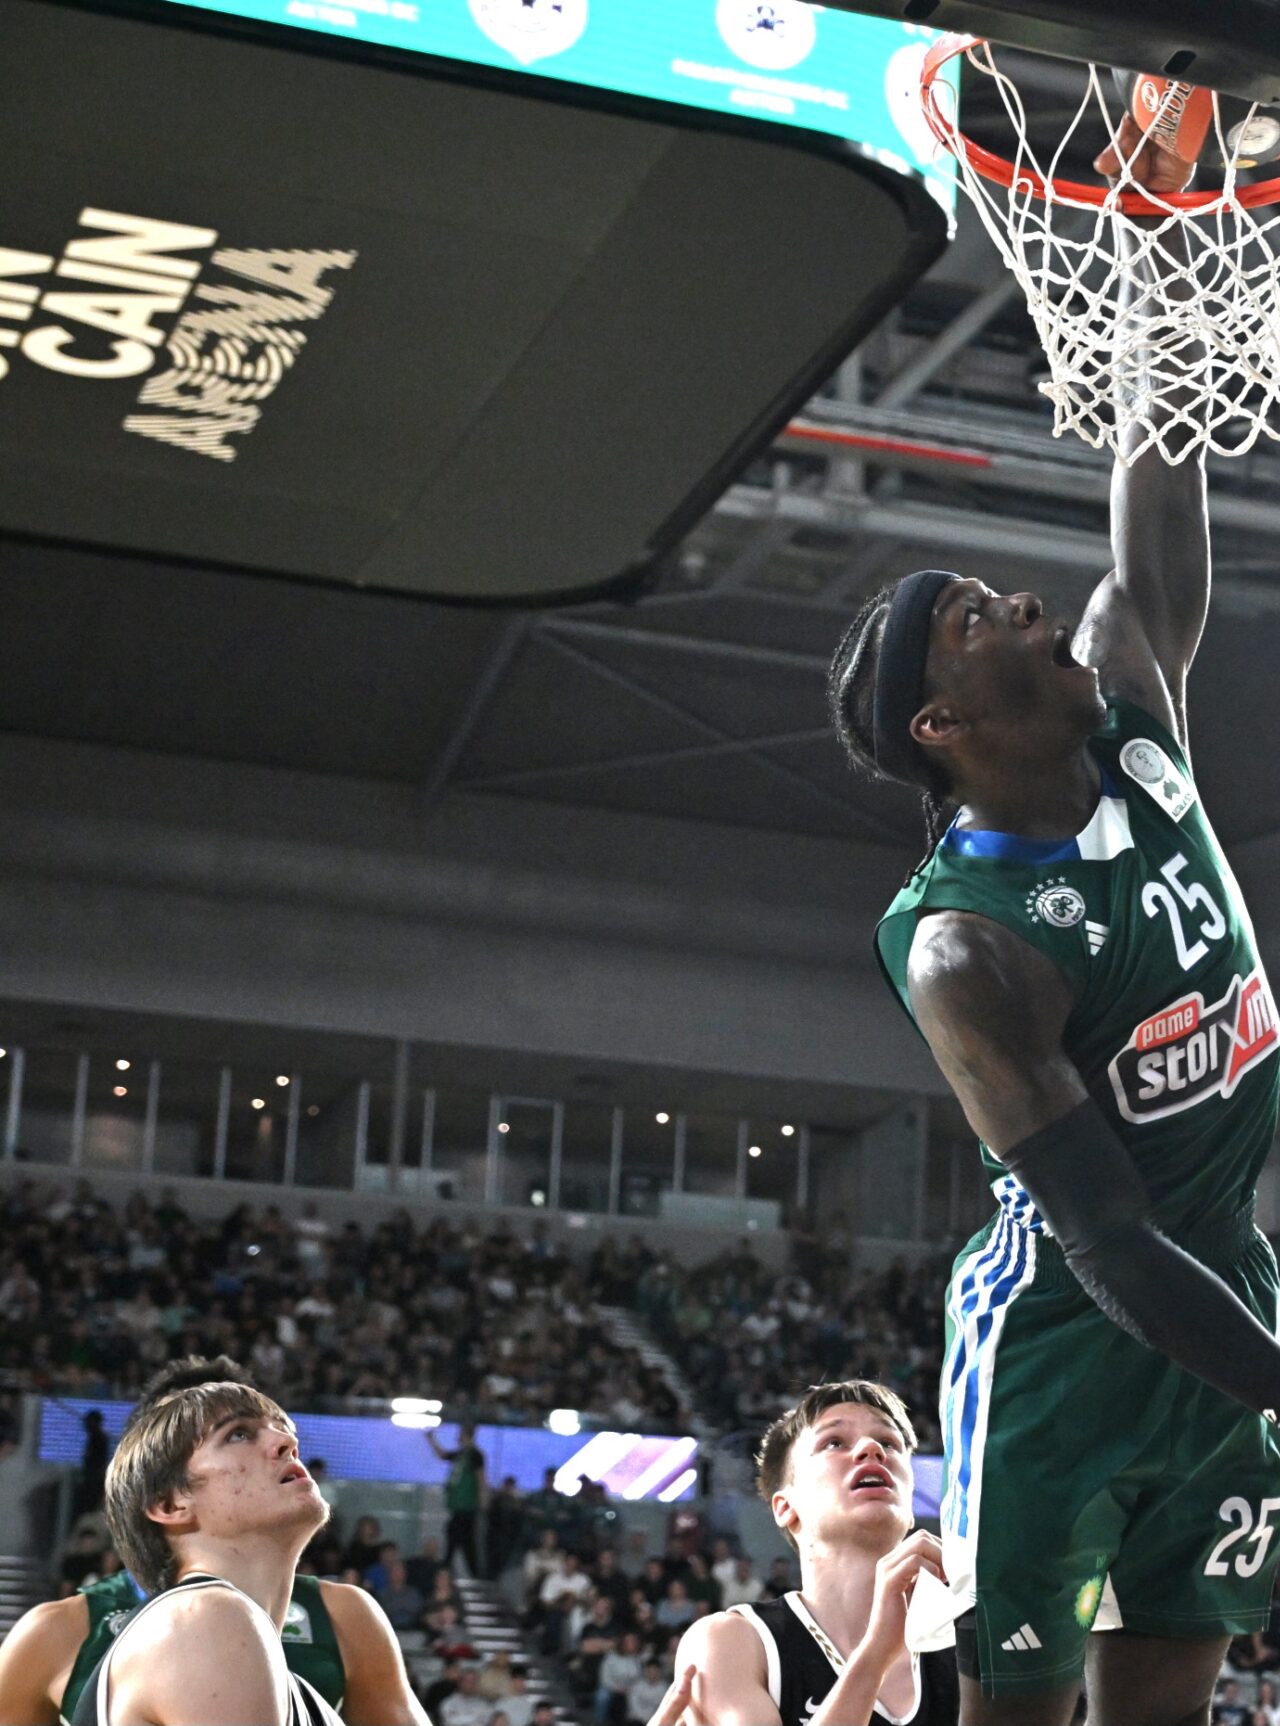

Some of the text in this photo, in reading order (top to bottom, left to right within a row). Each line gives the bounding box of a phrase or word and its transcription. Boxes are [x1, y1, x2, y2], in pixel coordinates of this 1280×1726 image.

[22, 207, 219, 379] CAIN
[122, 249, 359, 462] ARENA
[1141, 851, 1226, 971] 25
[1142, 1006, 1194, 1047] pame
